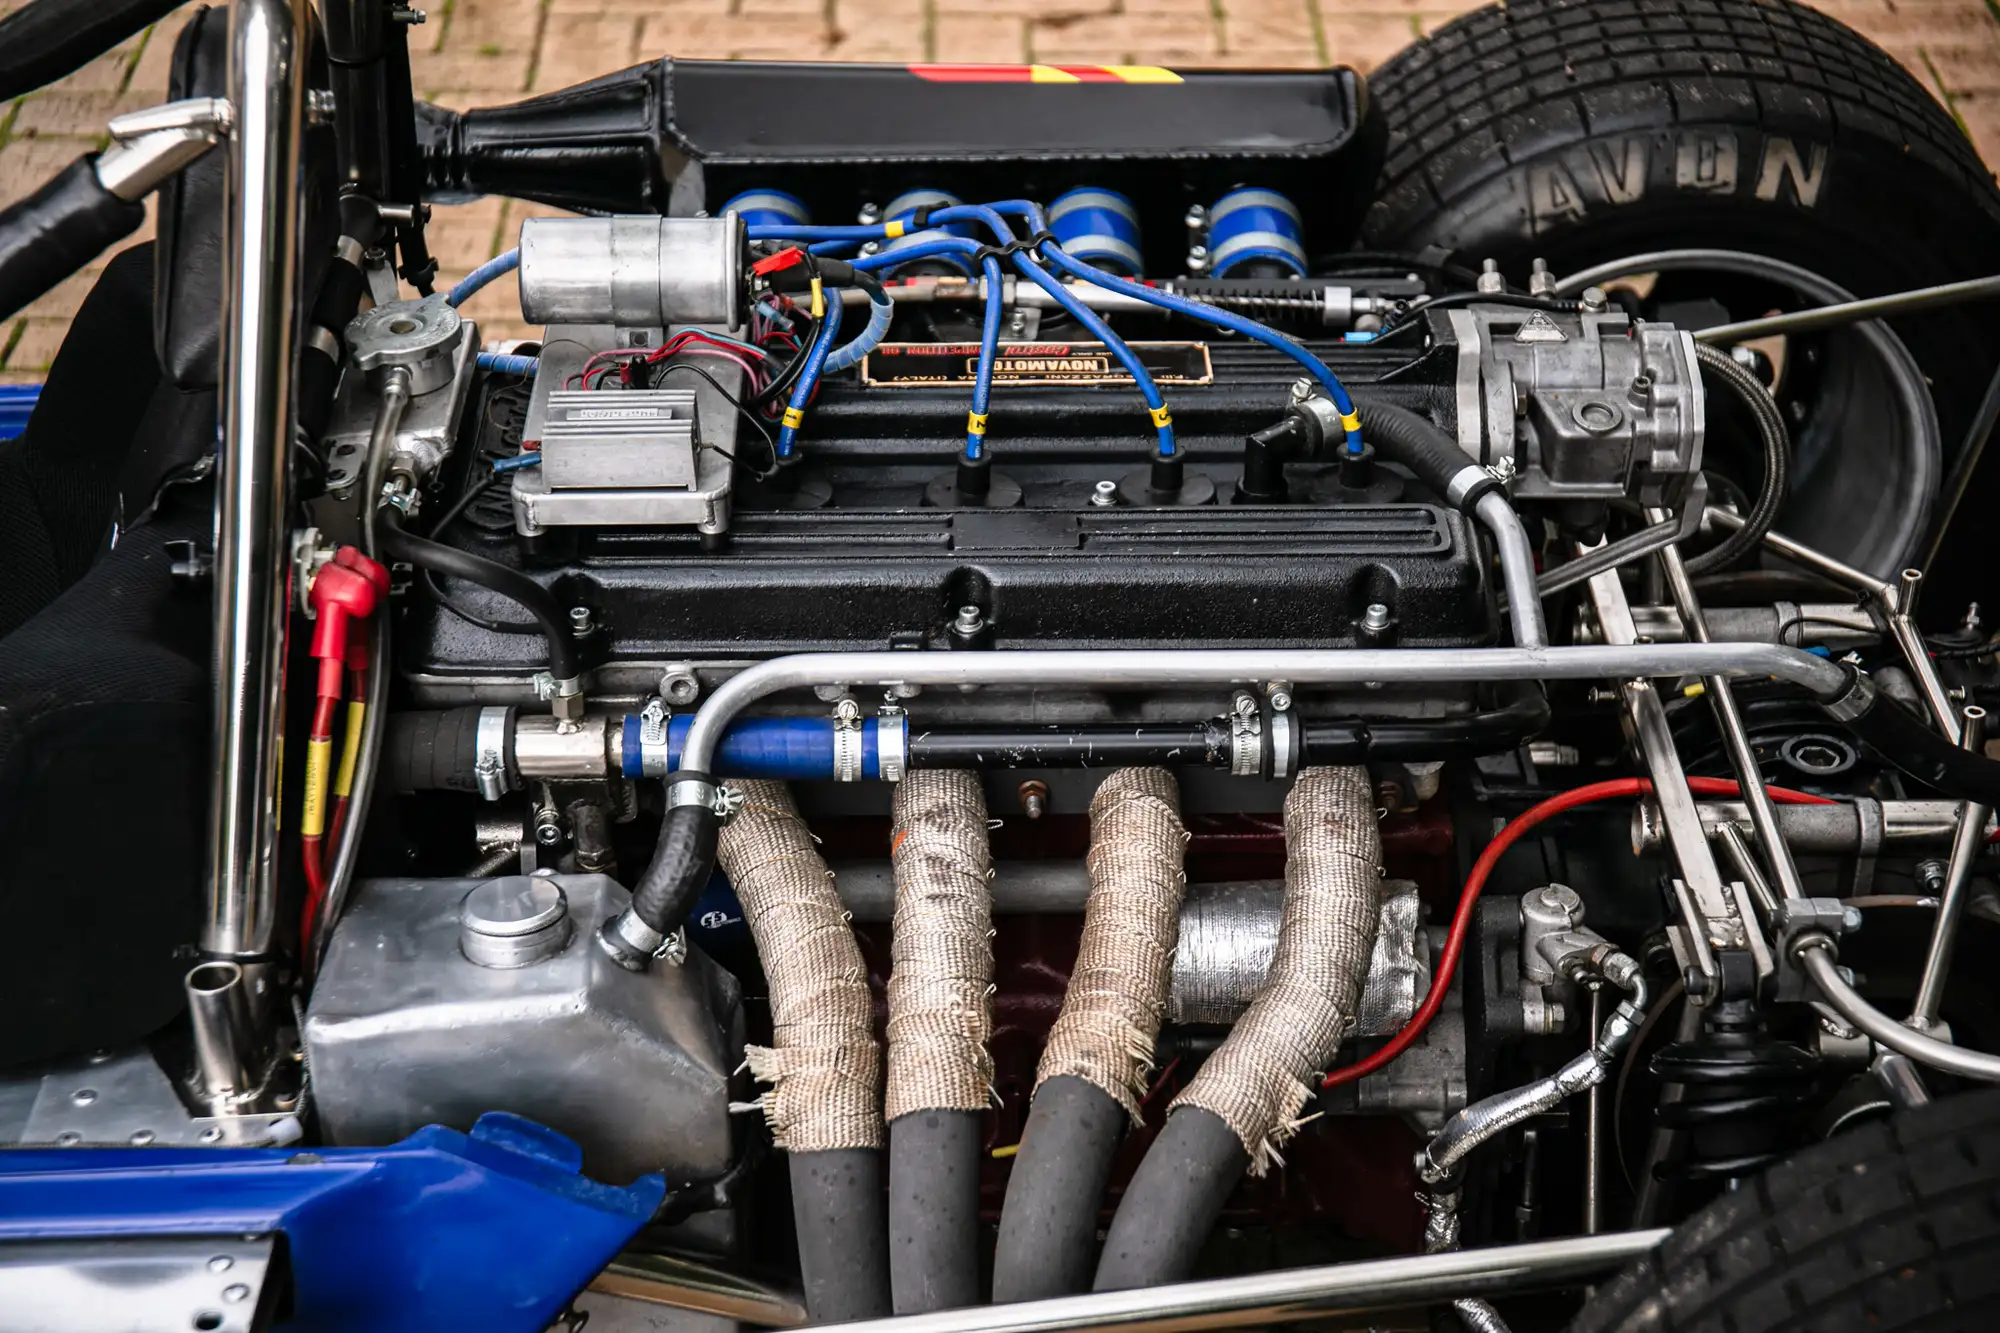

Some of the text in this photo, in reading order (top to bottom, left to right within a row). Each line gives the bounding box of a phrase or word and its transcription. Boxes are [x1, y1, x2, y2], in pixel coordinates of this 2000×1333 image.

[1527, 132, 1829, 234] AVON
[881, 346, 900, 356] OIL
[1004, 345, 1070, 359] Castrol
[992, 360, 1098, 371] NOVAMOTO
